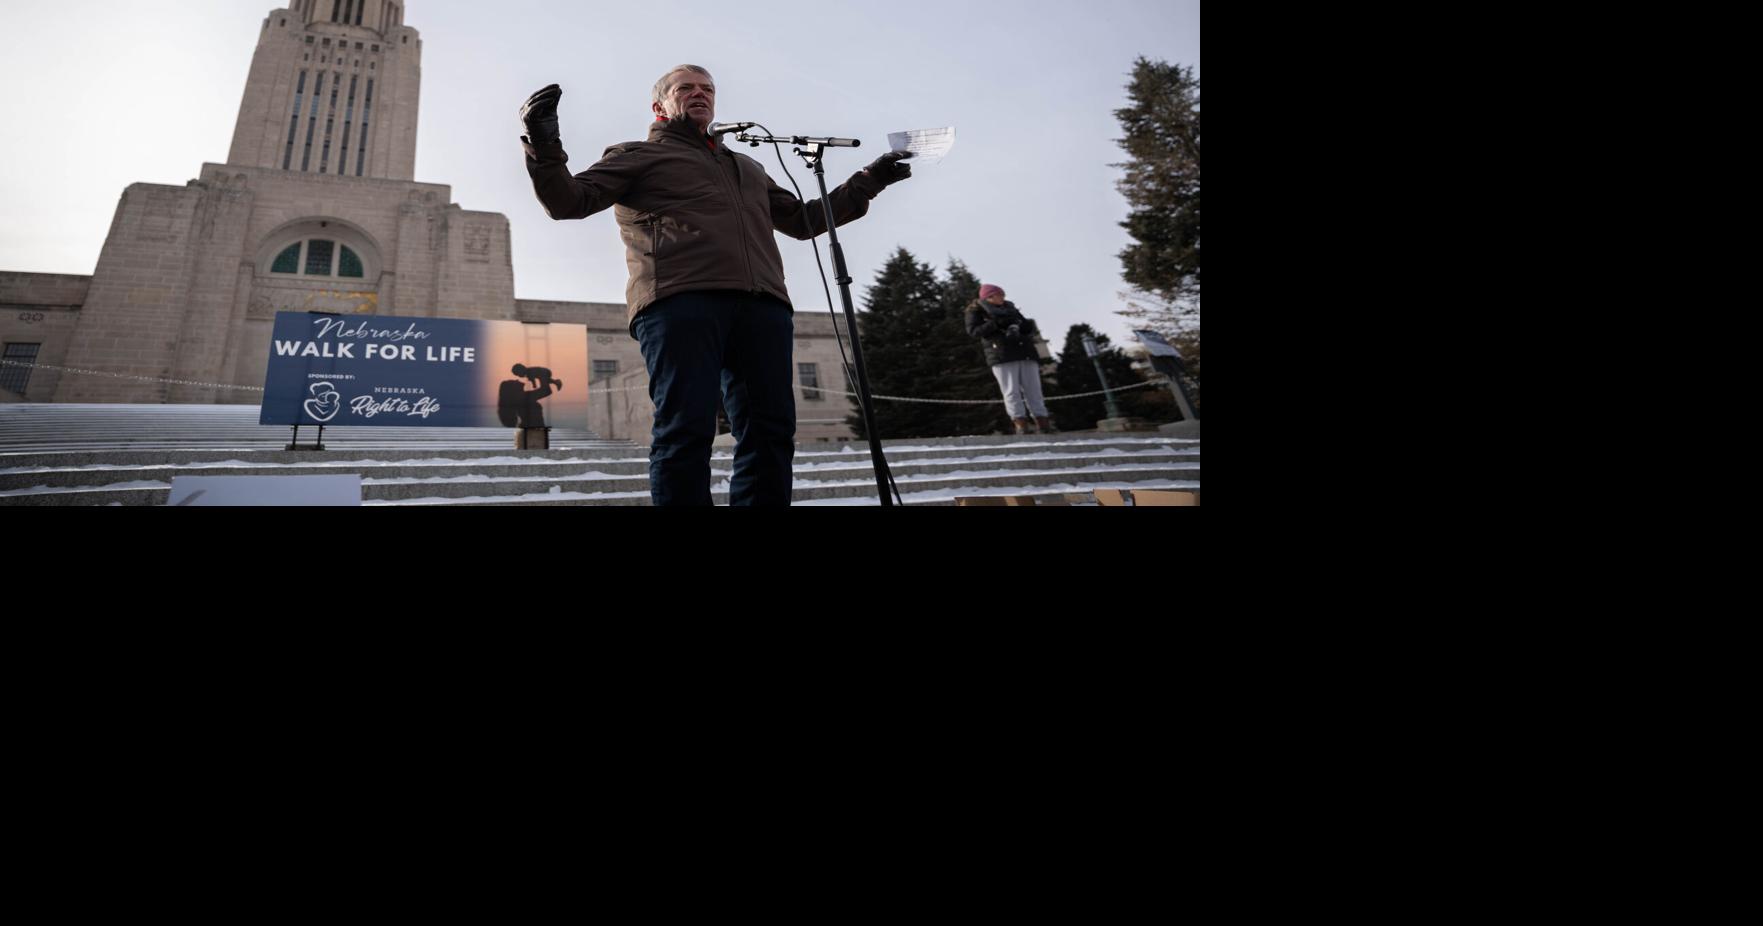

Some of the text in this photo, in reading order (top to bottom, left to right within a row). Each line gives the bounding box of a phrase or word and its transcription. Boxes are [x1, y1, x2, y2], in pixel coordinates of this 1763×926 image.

[313, 317, 431, 341] Nebraska
[275, 340, 475, 362] WALK FOR LIFE
[350, 395, 440, 418] Right to Life
